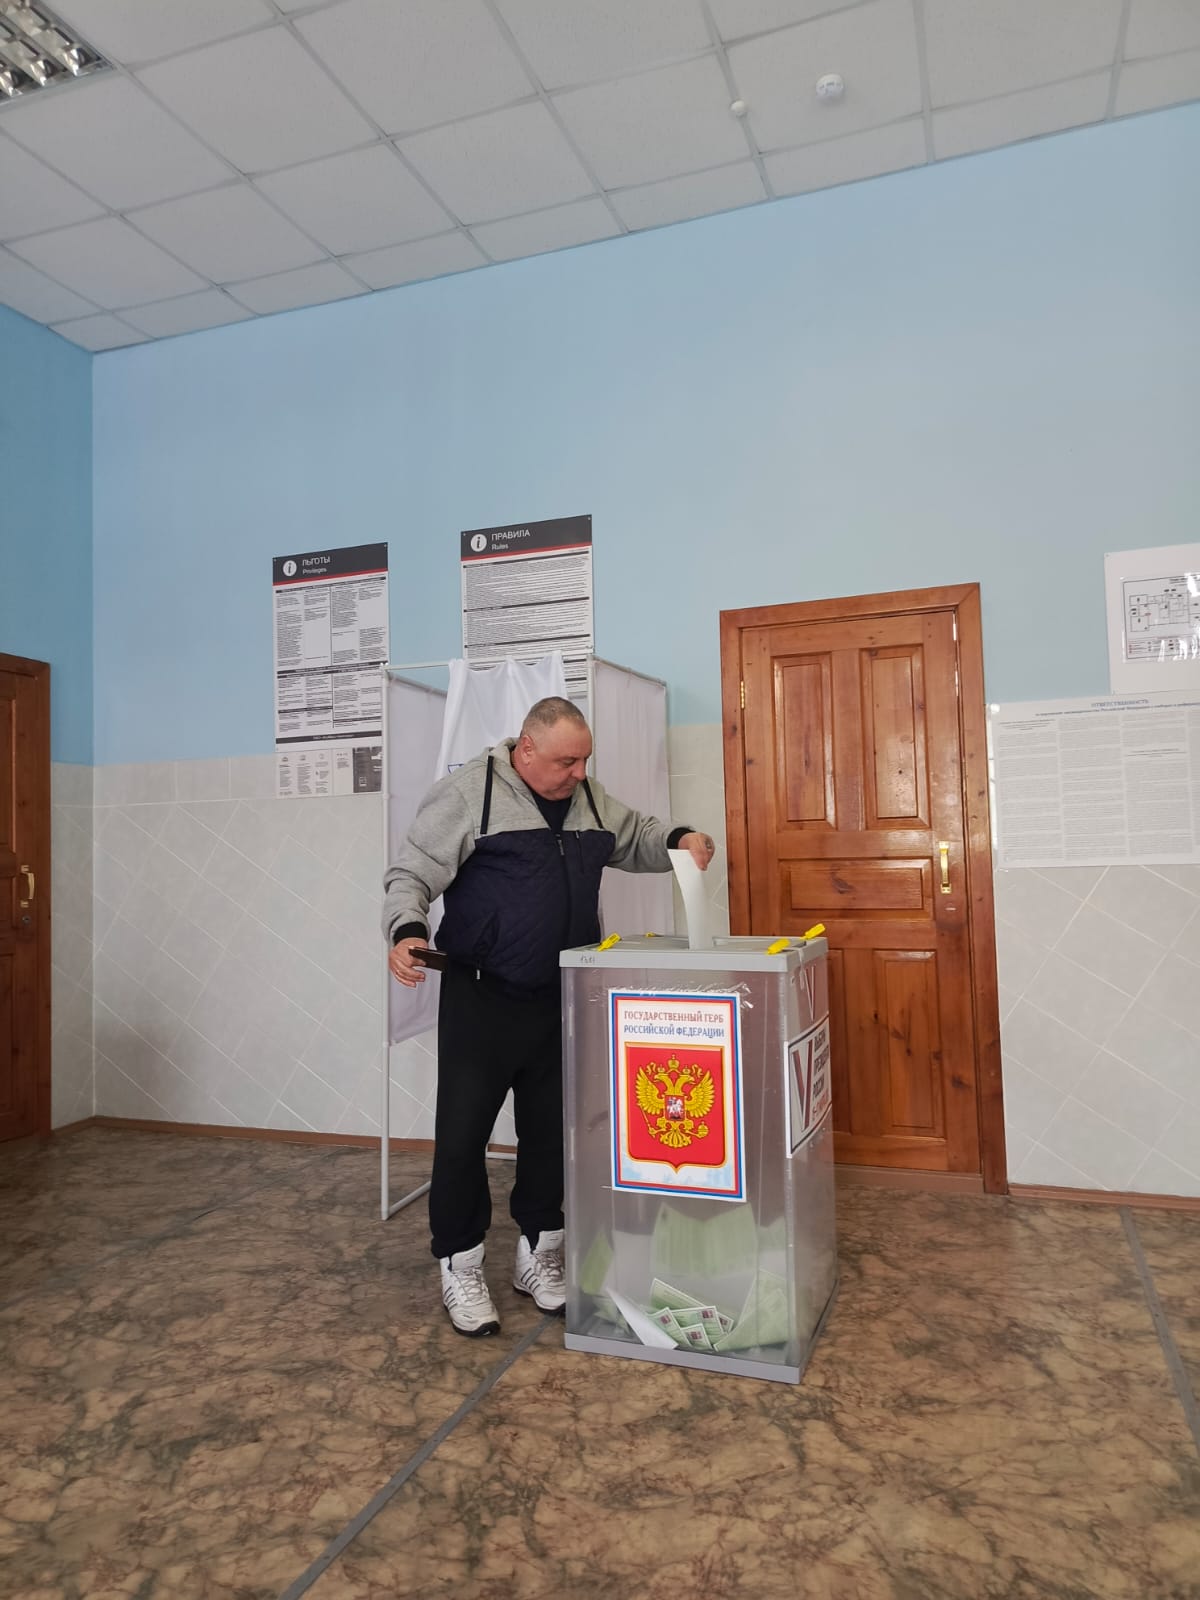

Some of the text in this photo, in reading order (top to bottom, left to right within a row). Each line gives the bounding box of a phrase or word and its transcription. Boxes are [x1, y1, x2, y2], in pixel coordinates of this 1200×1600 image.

[491, 529, 531, 541] ПРАВИЛА
[491, 543, 509, 551] Rules
[302, 556, 331, 567] ЛЬГОТЫ
[623, 1010, 725, 1024] ГОСУДАРСТВЕННЫЙ ГЕРБ
[623, 1023, 725, 1039] РОССИЙСКОЙ ФЕДЕРАЦИИ
